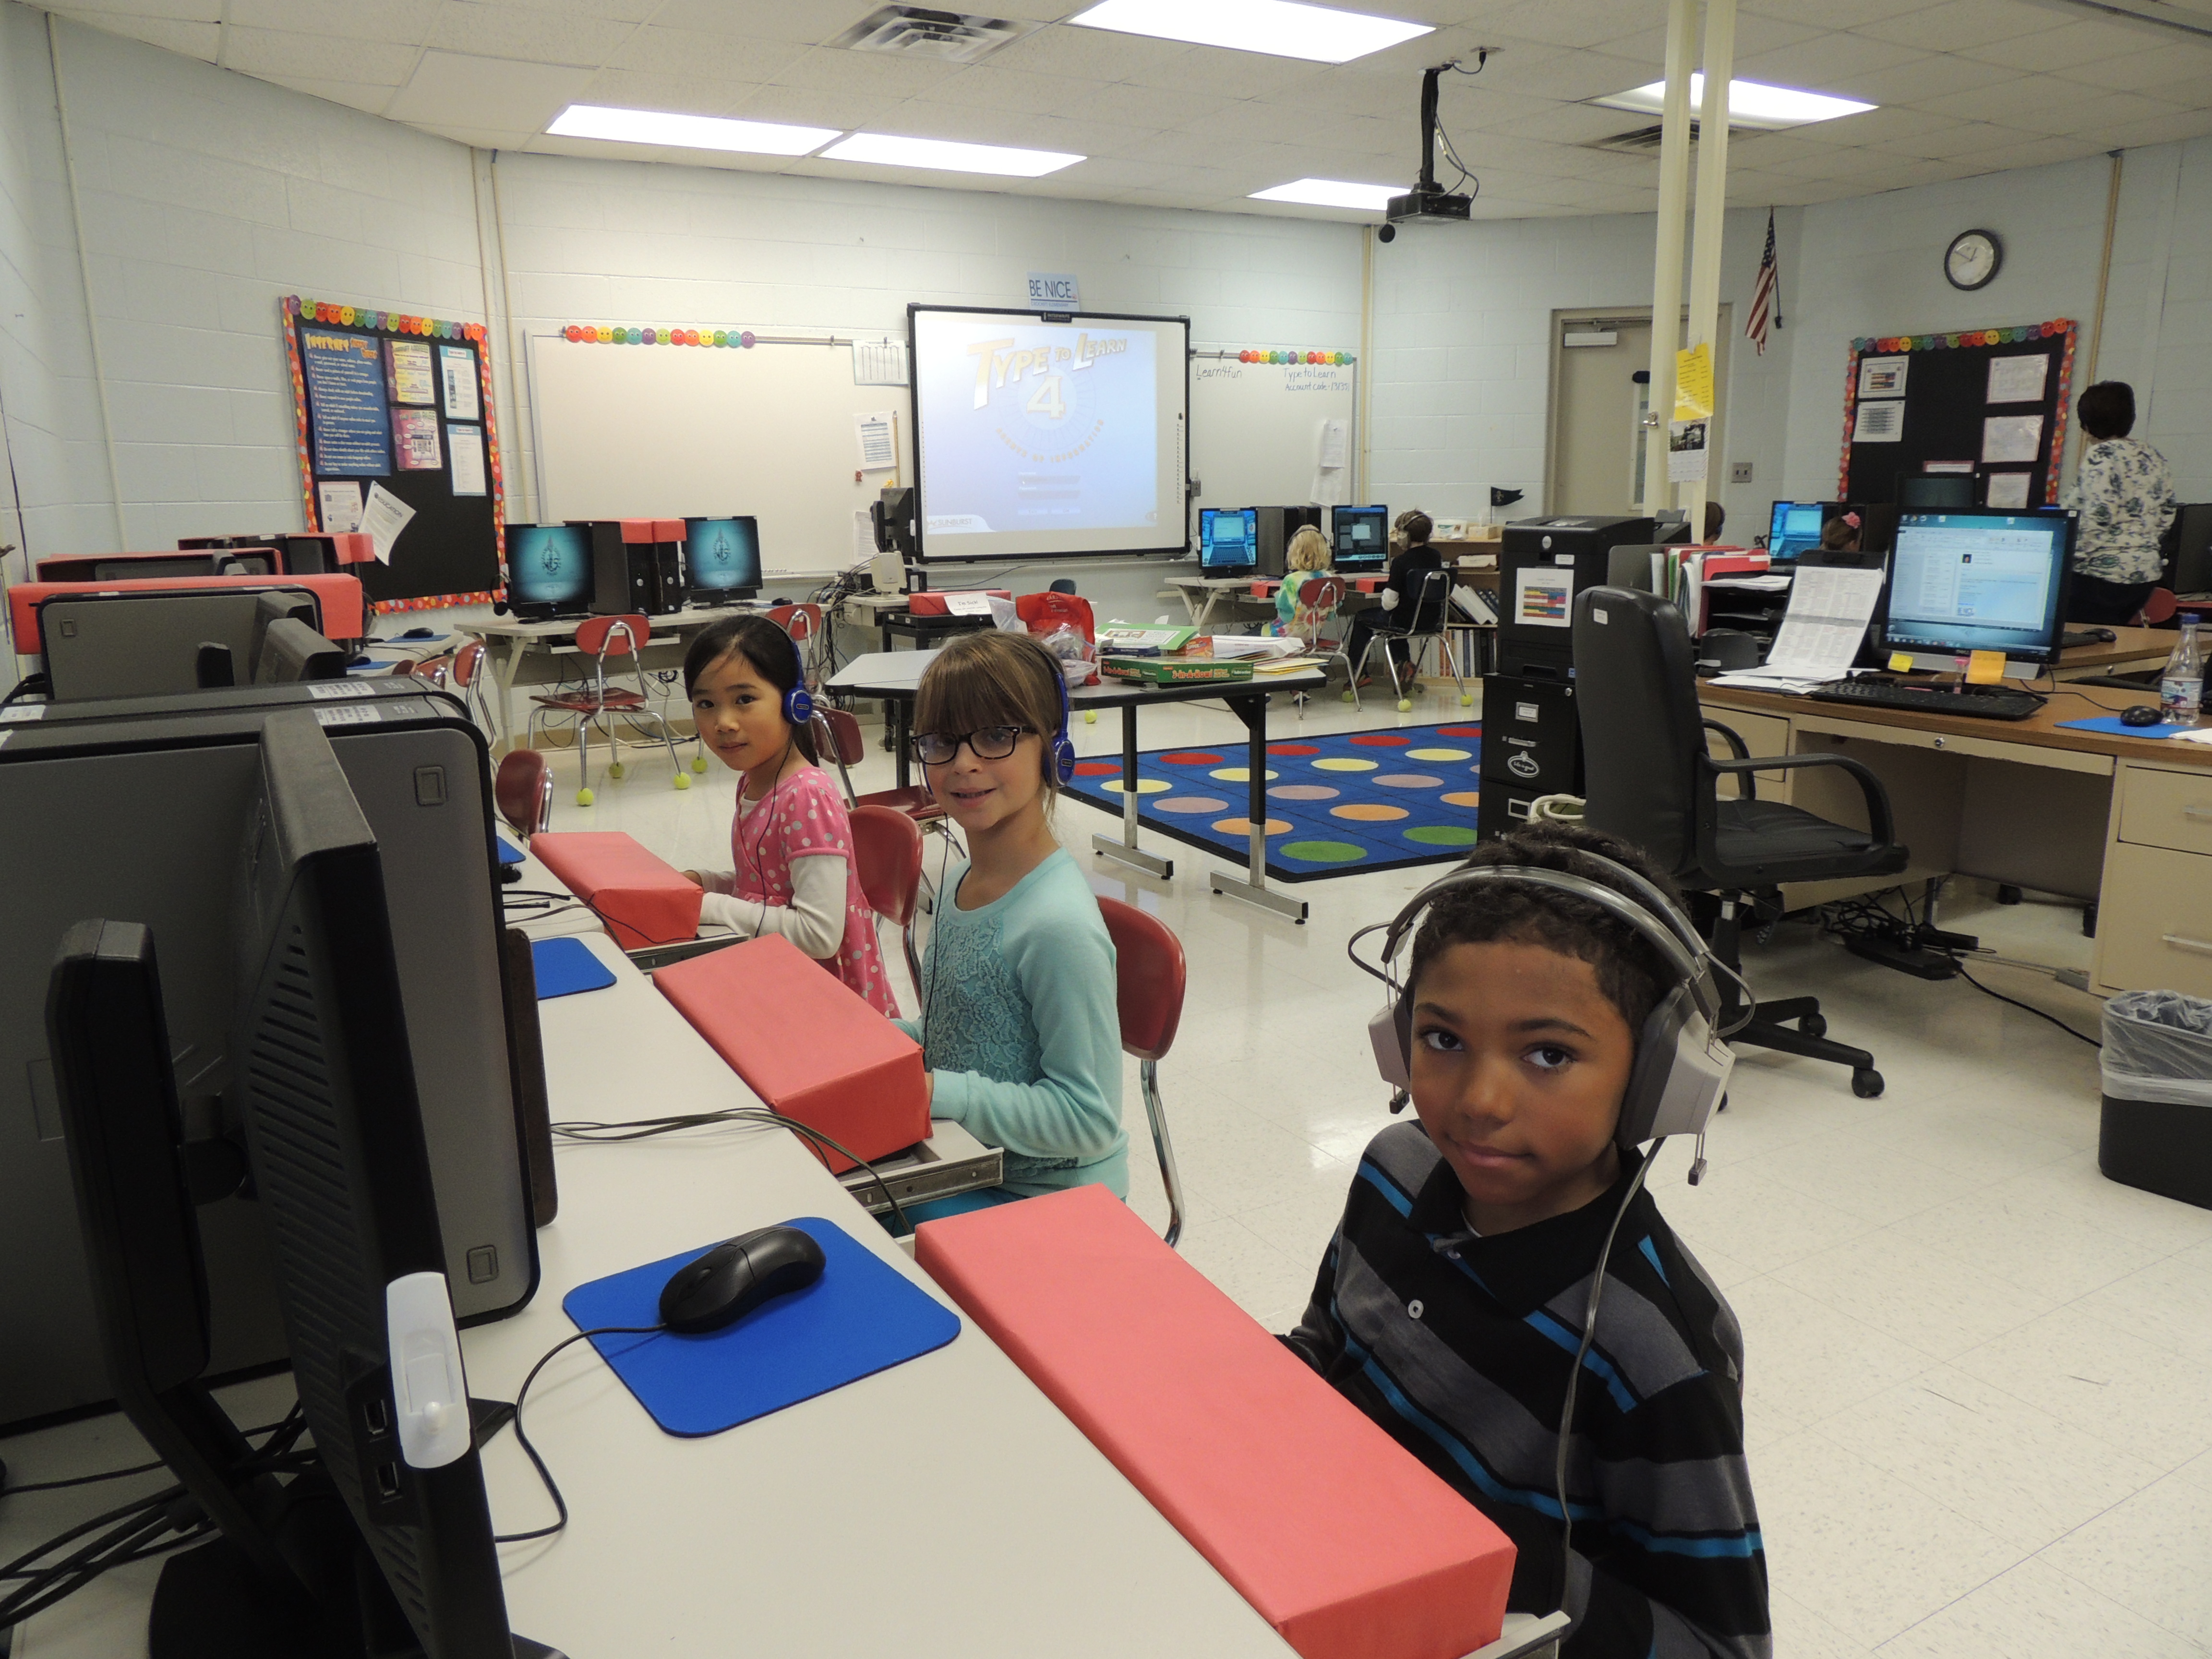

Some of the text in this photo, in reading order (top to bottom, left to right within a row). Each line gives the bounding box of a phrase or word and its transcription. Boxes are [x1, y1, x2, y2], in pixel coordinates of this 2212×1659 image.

[1029, 279, 1042, 297] BE
[966, 332, 1127, 410] TYPE TO LEARN
[1283, 367, 1336, 382] Type to Learn
[1285, 382, 1311, 391] Account
[1026, 375, 1066, 419] 4
[377, 495, 404, 518] EDUCATION
